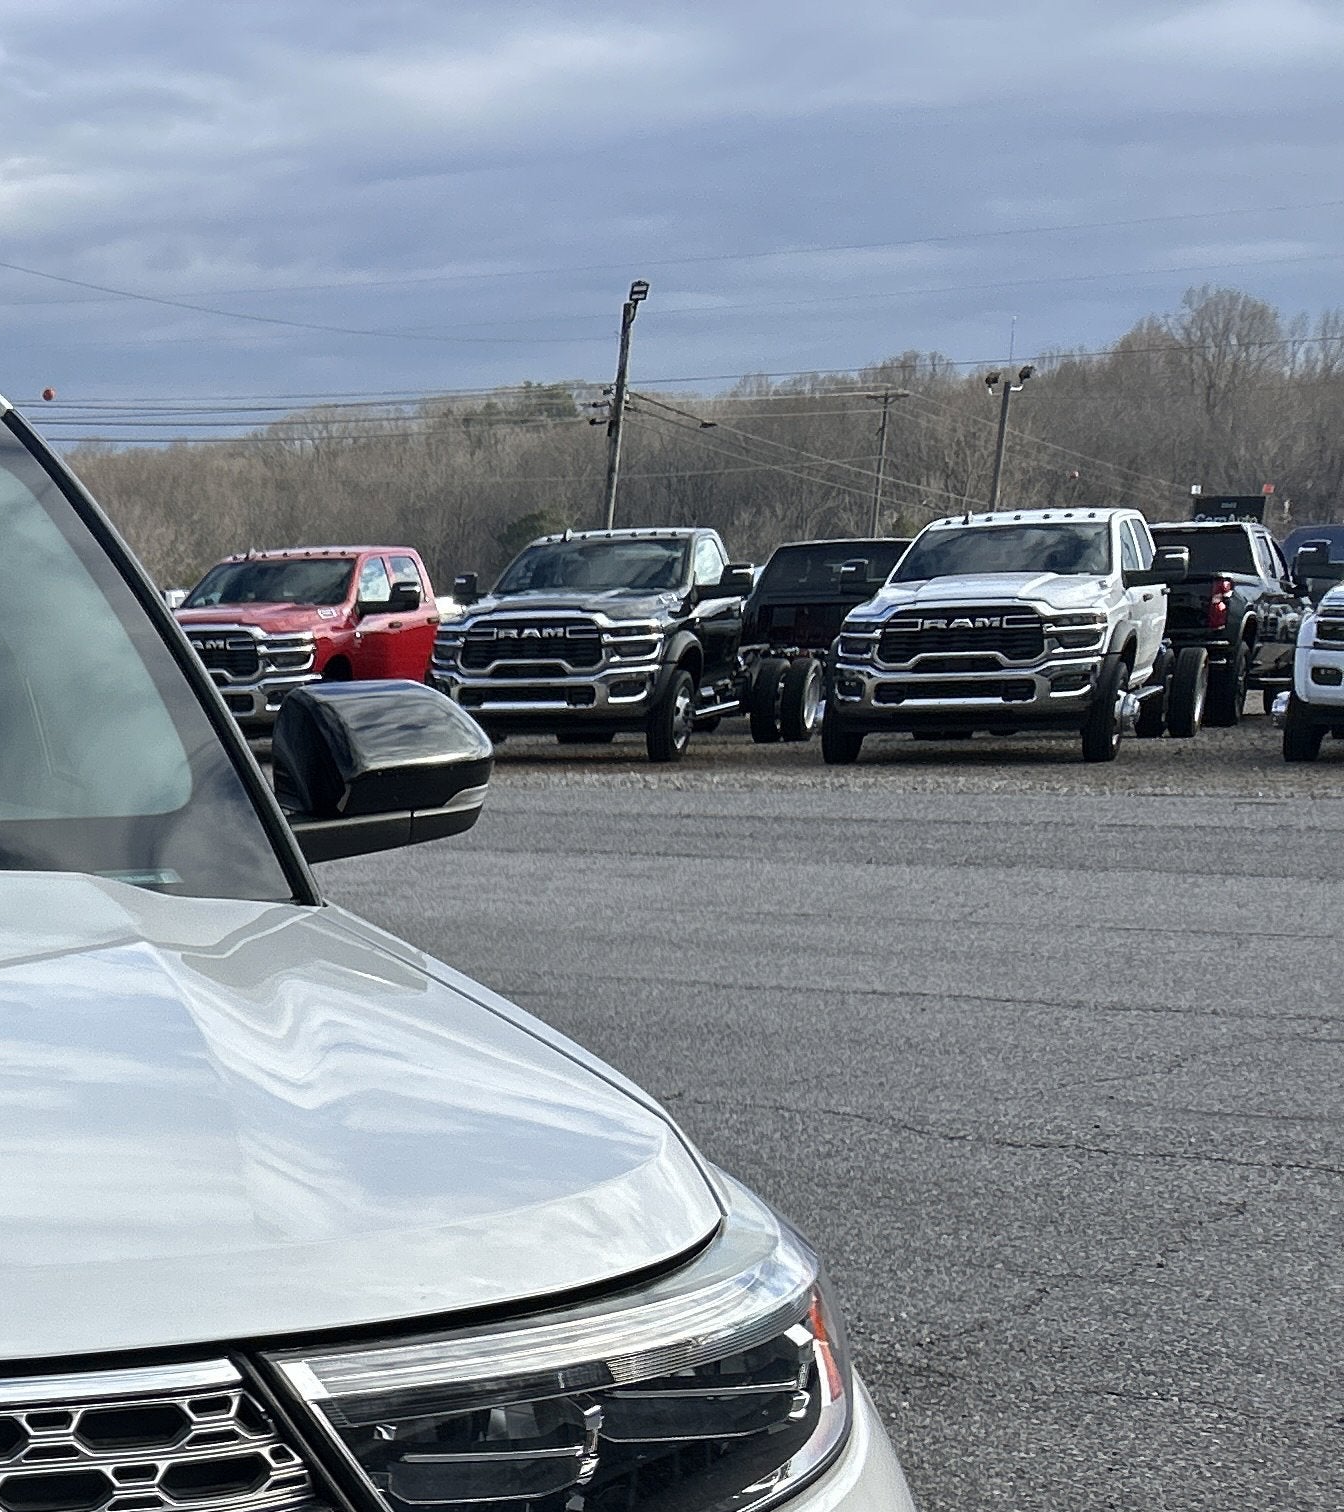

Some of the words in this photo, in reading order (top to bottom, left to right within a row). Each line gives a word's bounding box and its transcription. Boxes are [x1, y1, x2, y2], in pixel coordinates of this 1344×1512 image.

[922, 617, 1002, 630] RAM
[498, 627, 565, 639] RAM
[191, 640, 225, 650] AM
